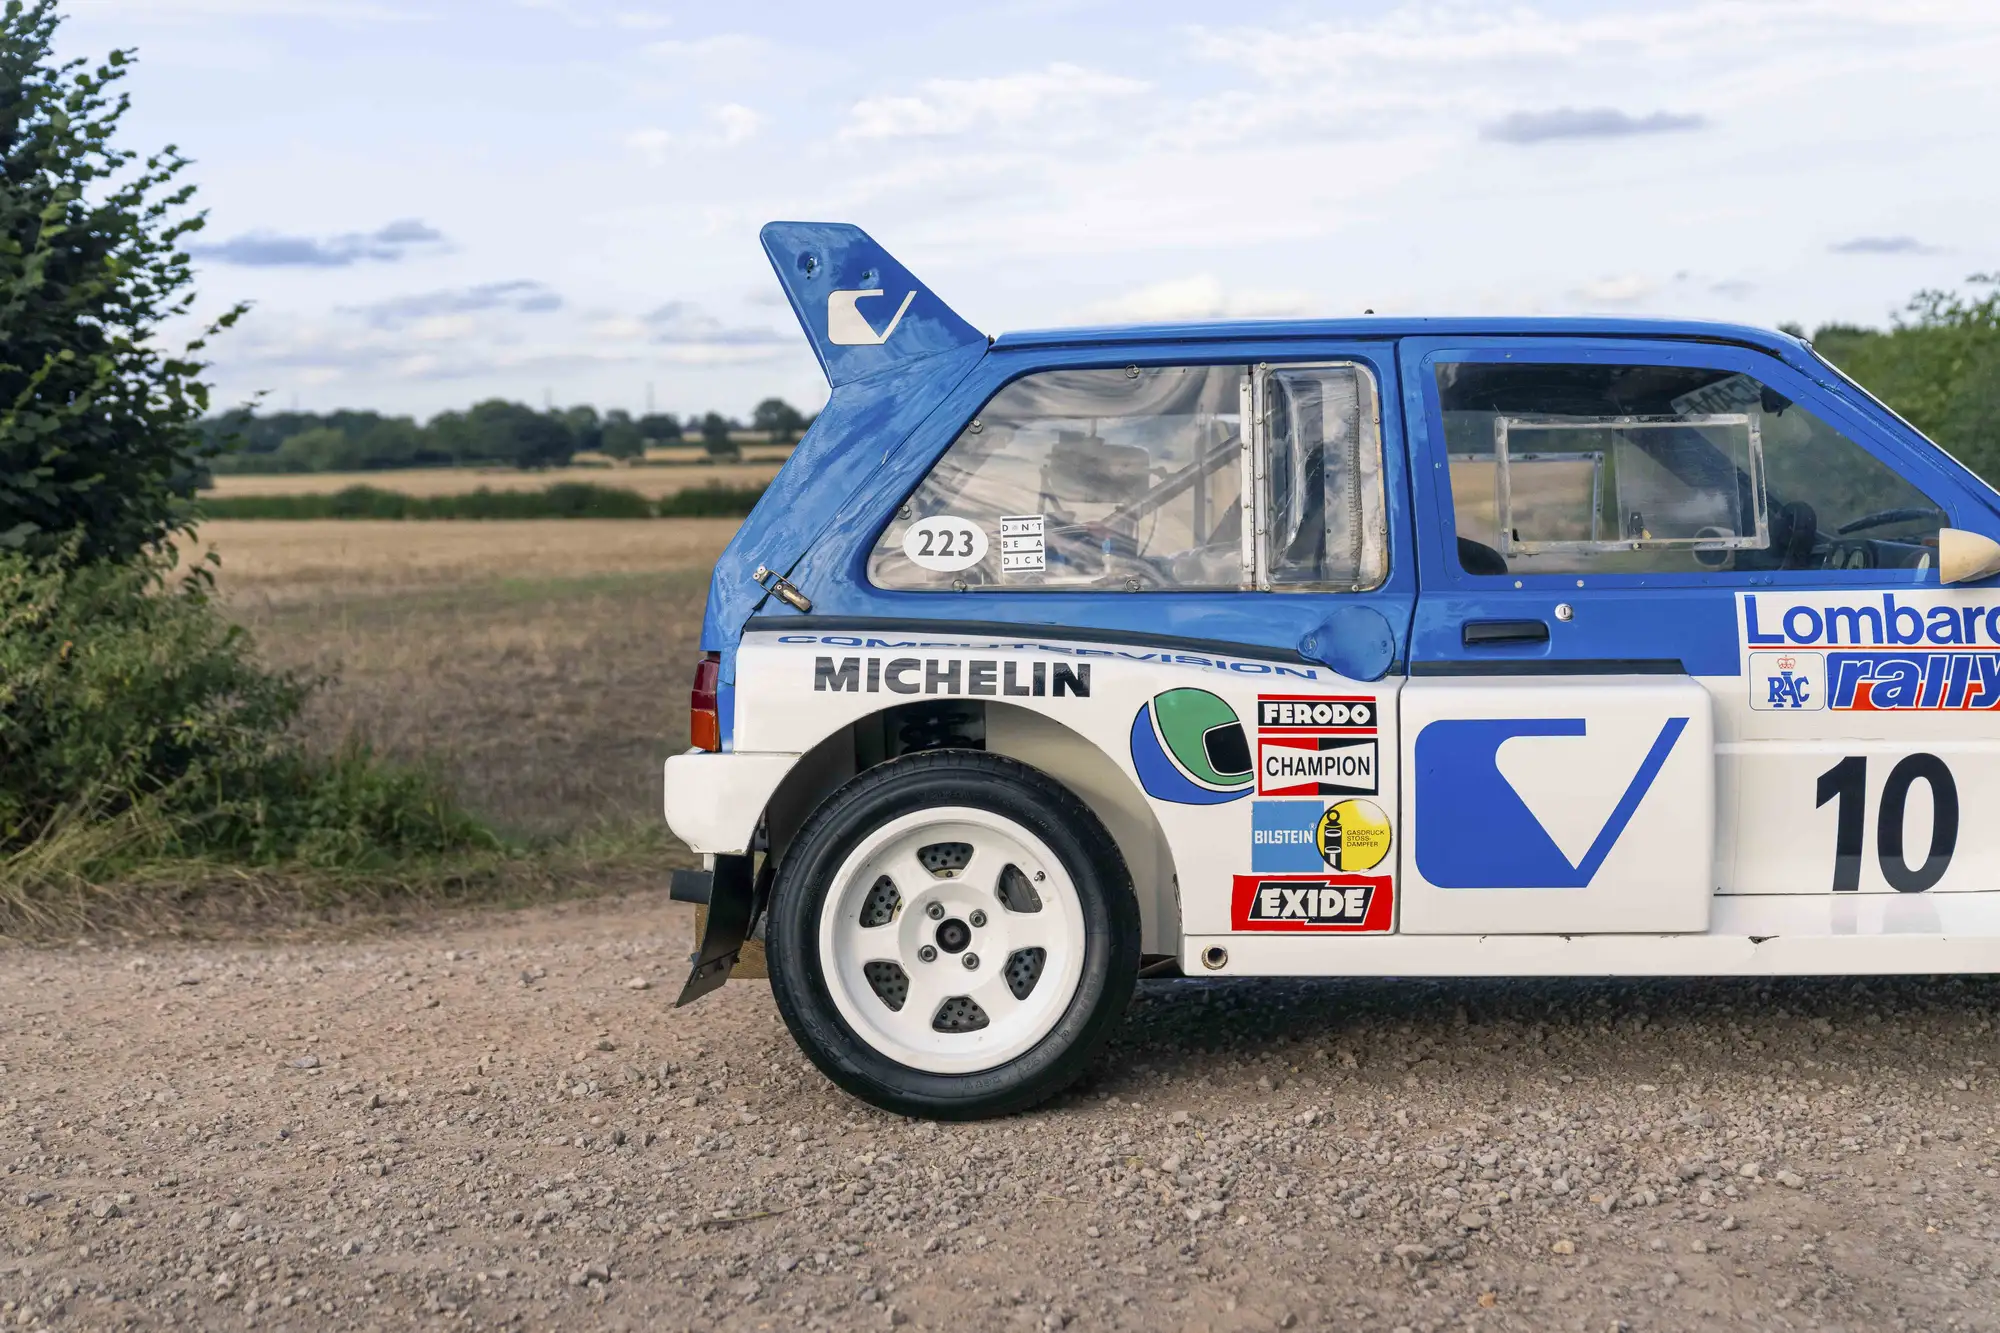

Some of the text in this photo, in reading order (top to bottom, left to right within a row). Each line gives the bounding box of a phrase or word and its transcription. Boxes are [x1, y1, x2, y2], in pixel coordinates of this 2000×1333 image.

[1002, 523, 1041, 531] DN'T
[917, 529, 974, 558] 223
[1004, 556, 1043, 564] DICK
[813, 656, 1091, 697] MICHELIN
[1767, 671, 1810, 708] RAC
[1263, 703, 1371, 724] FERODO
[1266, 756, 1371, 776] CHAMPION
[1815, 752, 1960, 893] 10
[1254, 828, 1314, 844] BILSTEIN
[1259, 888, 1366, 918] EXIDE
